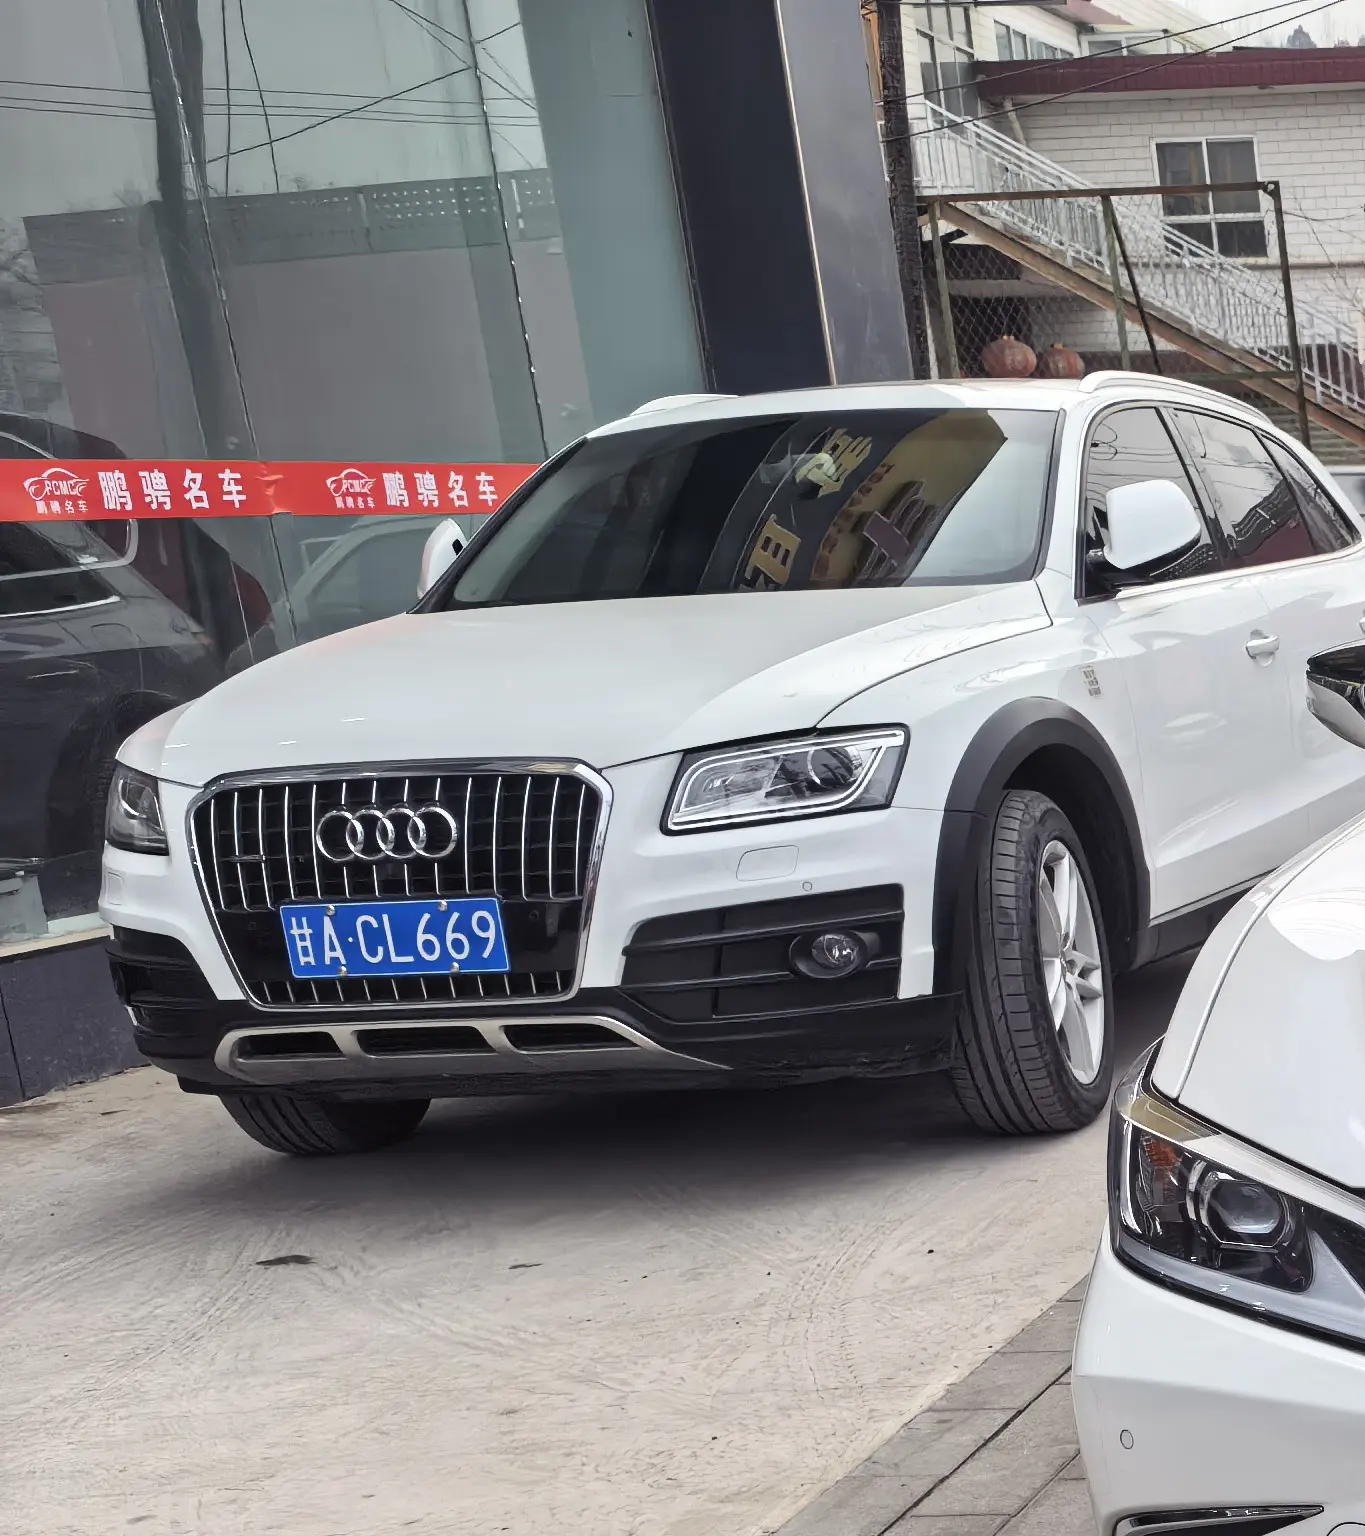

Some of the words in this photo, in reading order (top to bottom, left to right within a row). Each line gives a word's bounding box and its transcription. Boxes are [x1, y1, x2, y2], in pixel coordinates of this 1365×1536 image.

[97, 468, 247, 511] 鹏骋名车
[382, 470, 498, 508] 鹏骋名车
